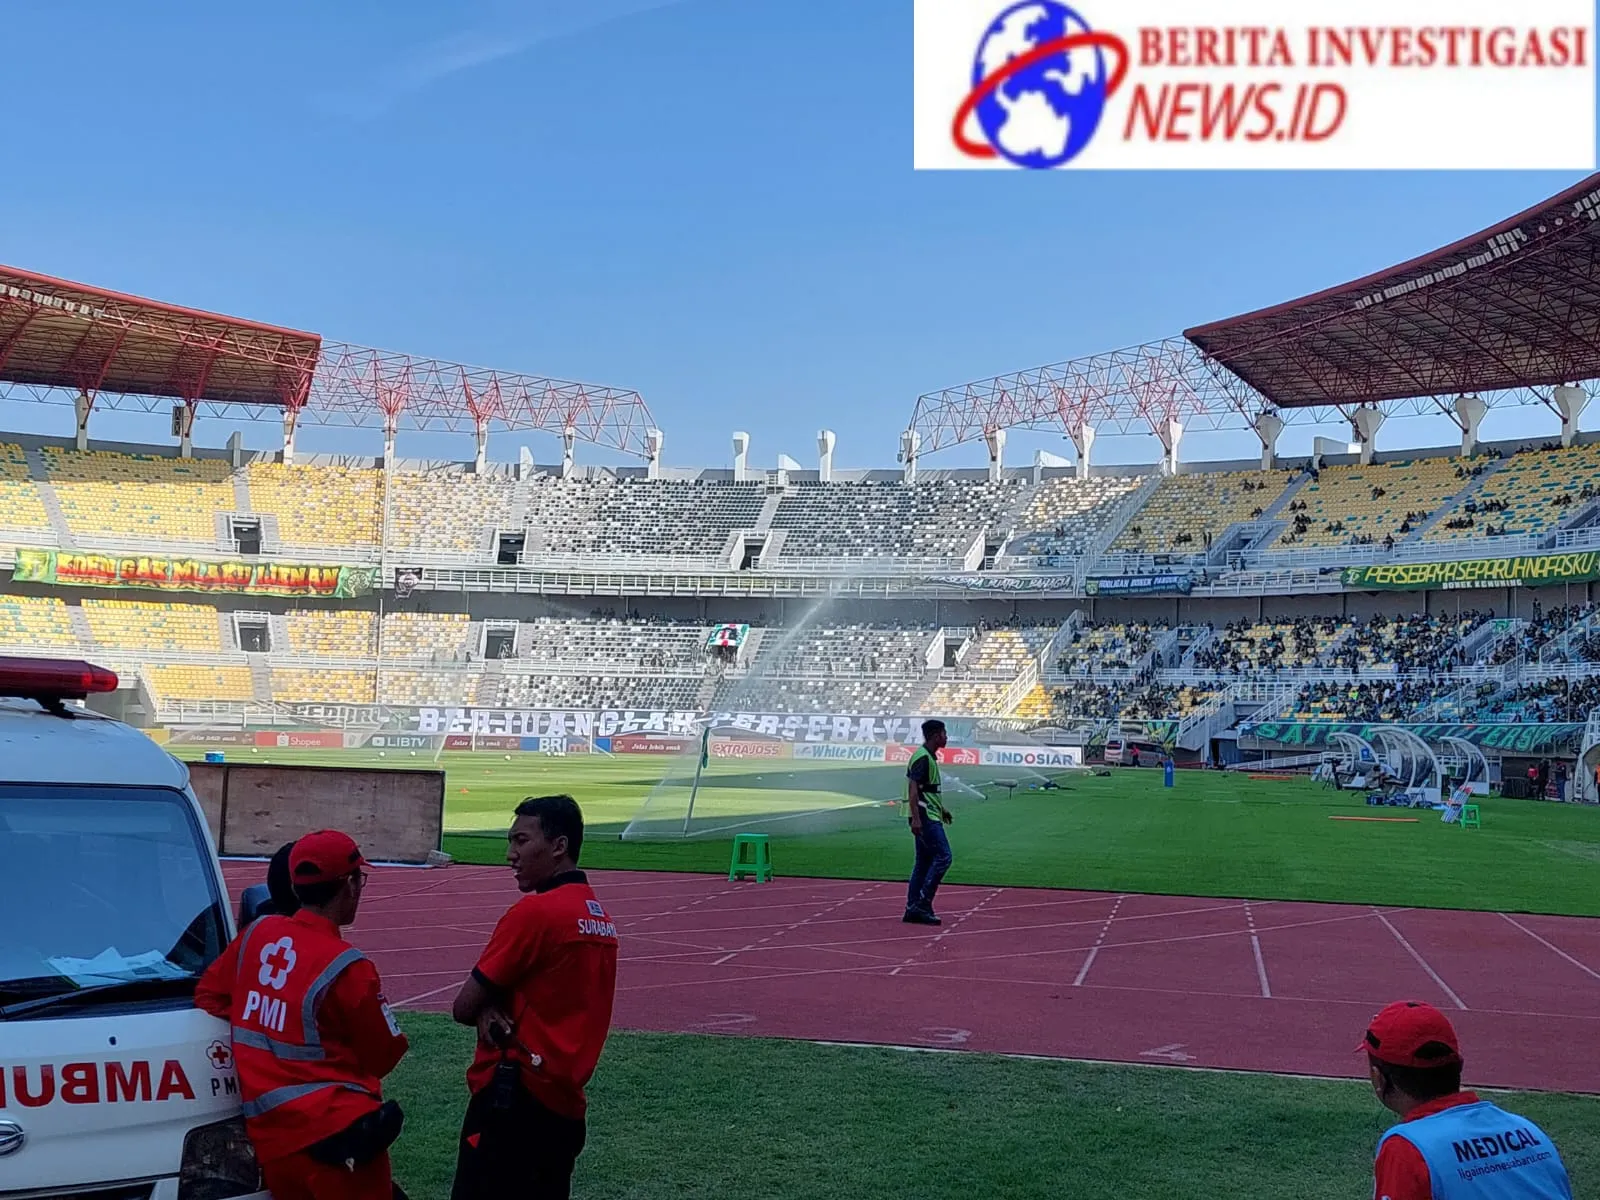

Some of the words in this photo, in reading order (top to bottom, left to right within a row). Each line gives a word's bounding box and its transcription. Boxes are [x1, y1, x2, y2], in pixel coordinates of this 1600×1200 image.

[708, 711, 926, 745] PERSEBAYA
[290, 737, 321, 748] Shopee
[711, 743, 781, 756] EXTRAJOSS
[811, 744, 846, 758] White
[845, 744, 884, 760] Koffie
[997, 751, 1073, 765] INDOSIAR
[242, 990, 287, 1032] PMI
[210, 1077, 238, 1097] PM
[1452, 1128, 1541, 1163] MEDICAL
